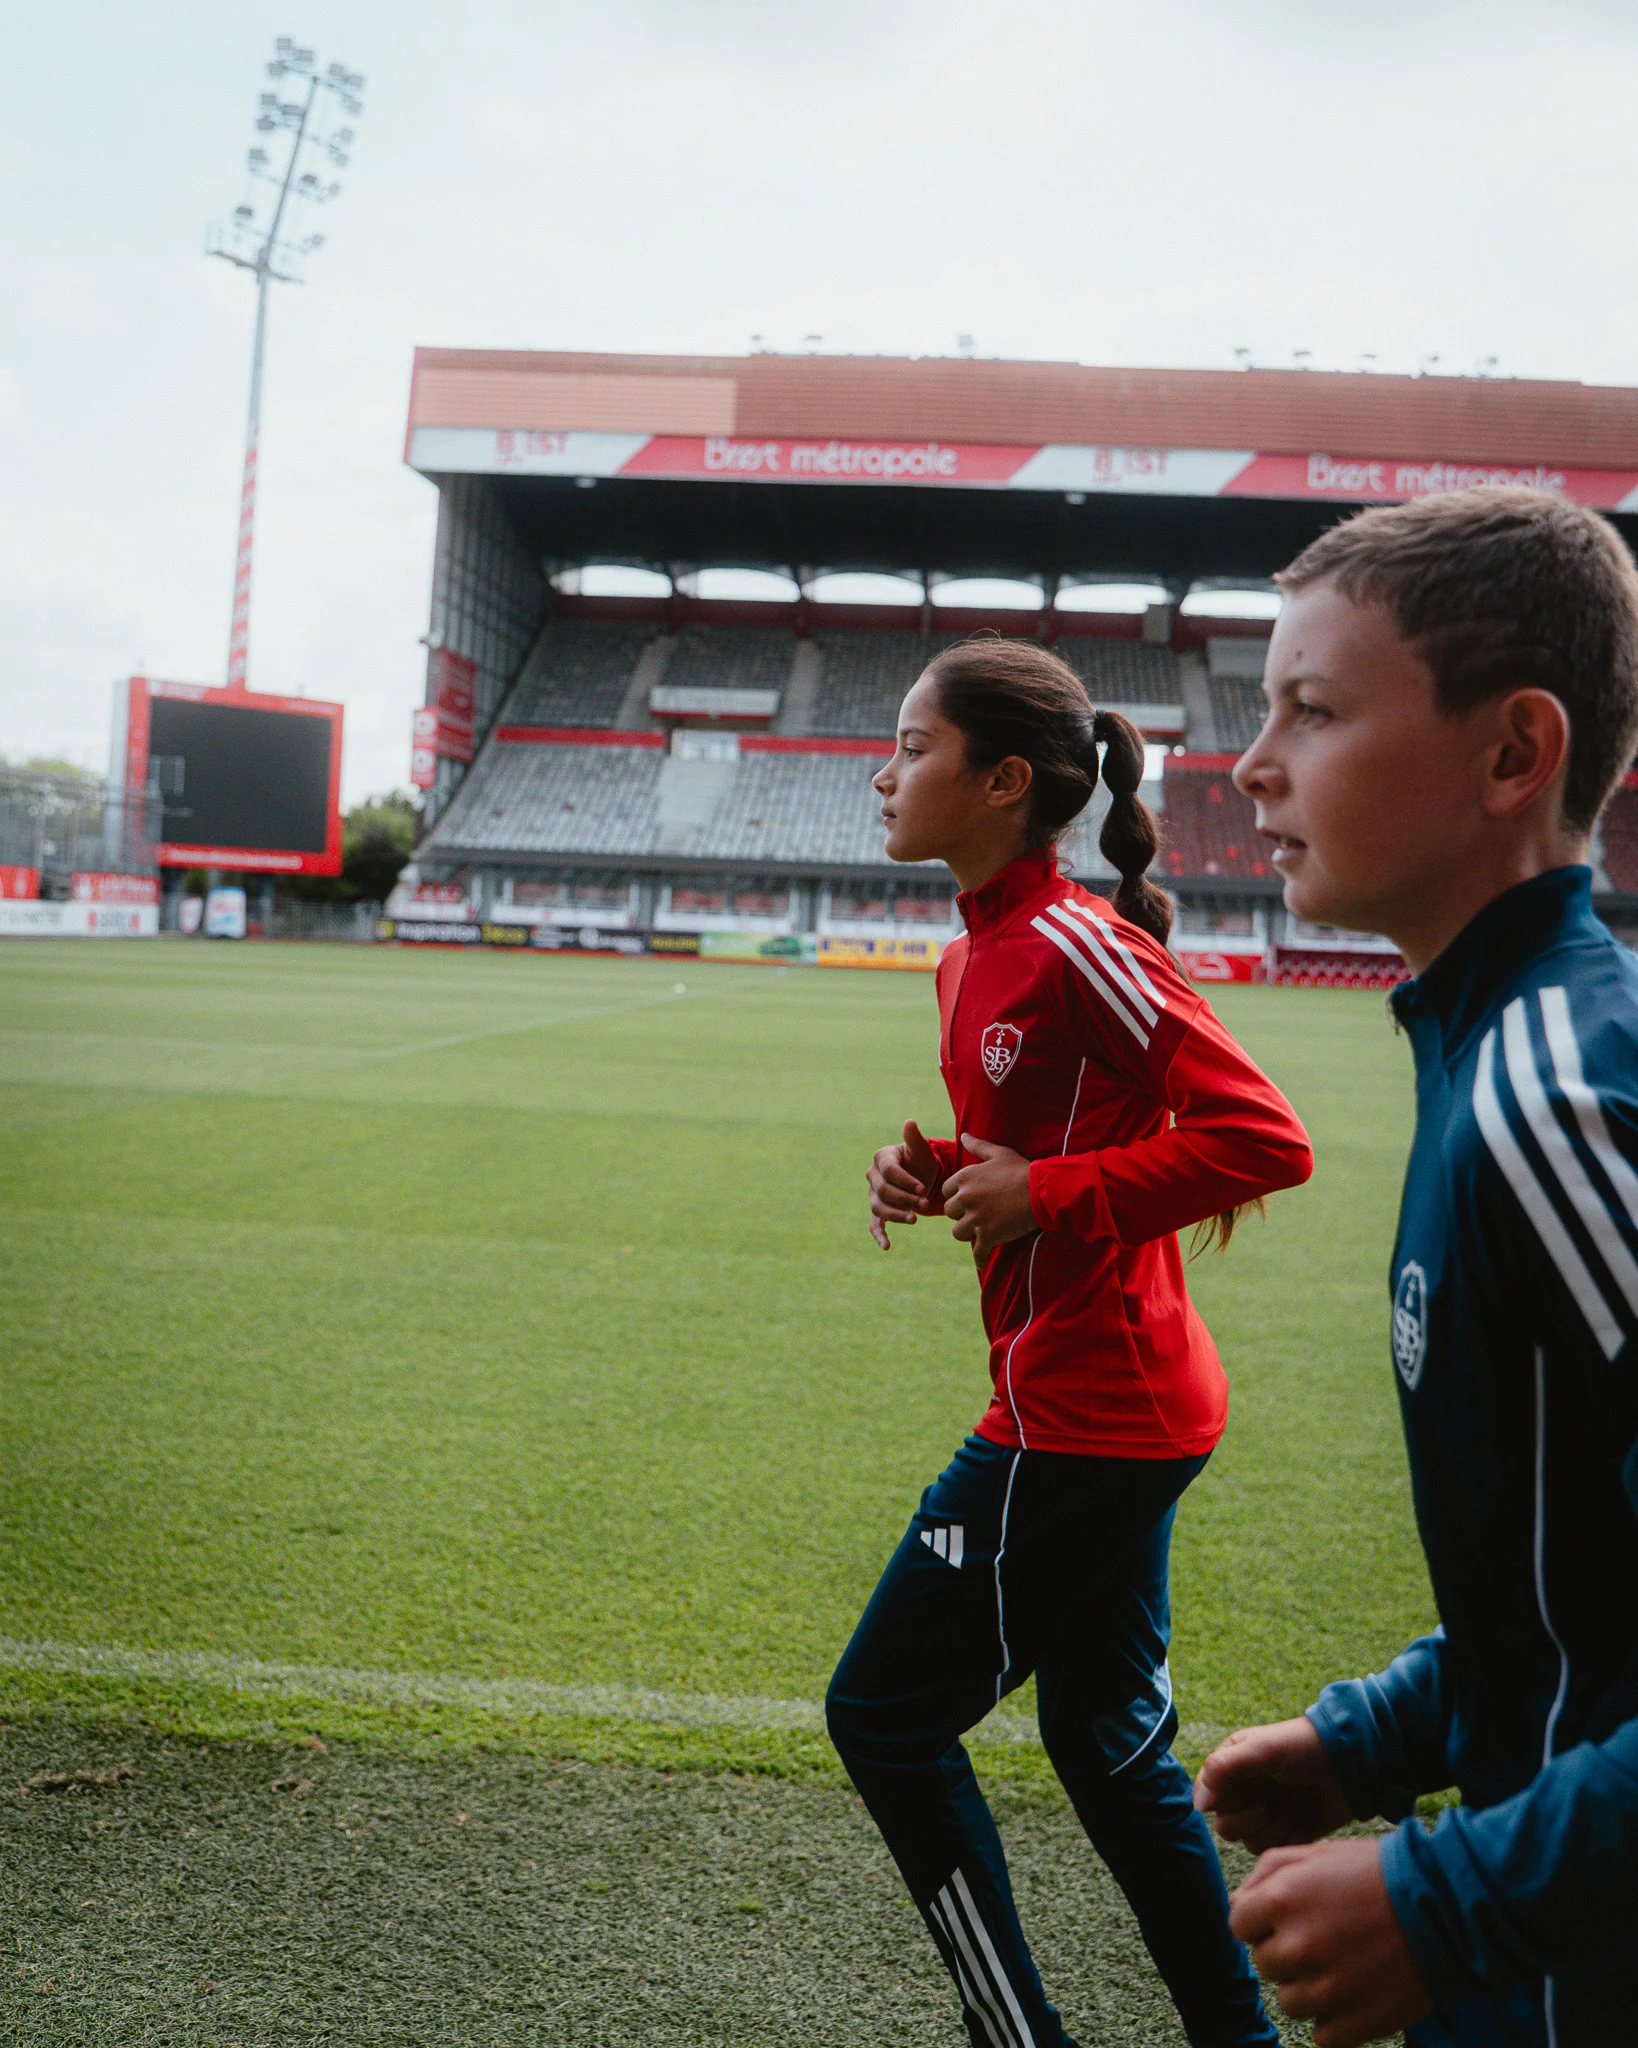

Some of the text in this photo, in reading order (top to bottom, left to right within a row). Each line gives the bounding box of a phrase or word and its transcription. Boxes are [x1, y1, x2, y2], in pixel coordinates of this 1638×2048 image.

[790, 440, 959, 480] métropole
[1307, 452, 1385, 492] Brest
[984, 1045, 1012, 1065] SB
